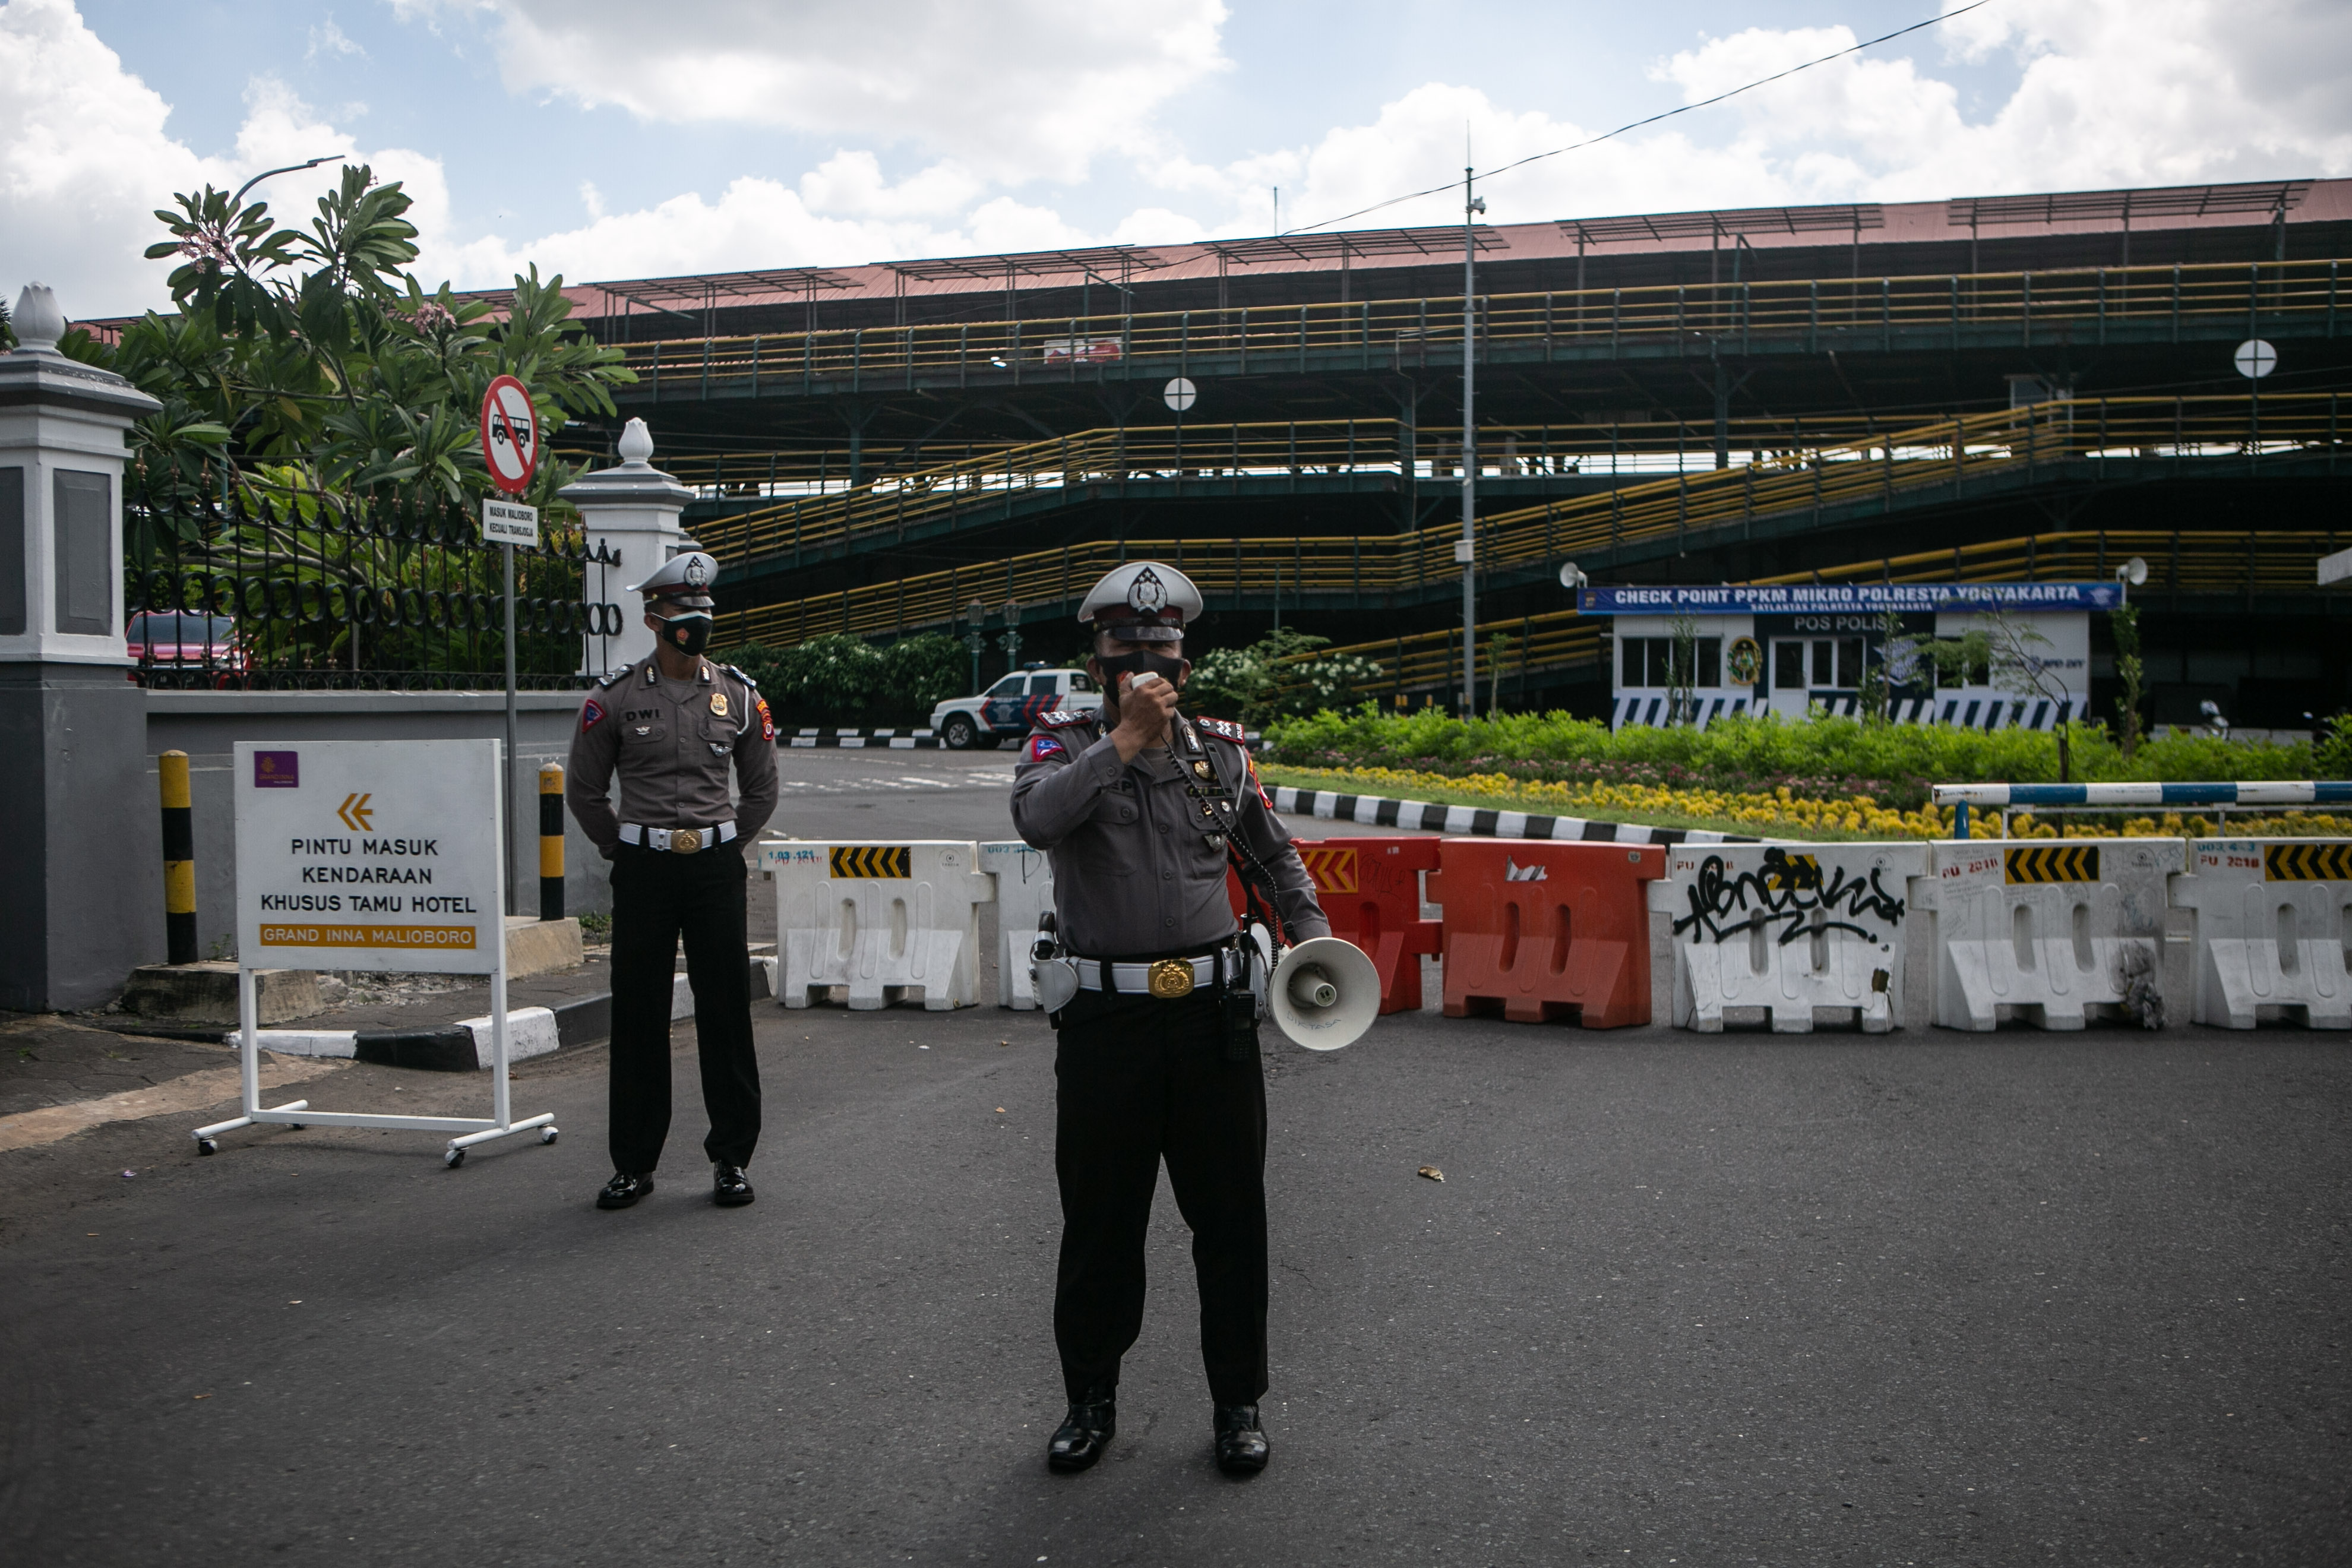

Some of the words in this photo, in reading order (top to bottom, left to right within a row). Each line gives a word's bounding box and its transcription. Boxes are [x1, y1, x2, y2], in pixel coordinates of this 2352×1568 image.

[489, 506, 507, 518] MASUK
[508, 508, 533, 521] MALIOBORO
[489, 523, 507, 533] KECUALI
[508, 524, 533, 537] TRANSJOGJA
[1615, 590, 1672, 604] CHECK
[1677, 589, 1730, 603] POINT
[1734, 589, 1787, 603] PPKM
[1792, 587, 1852, 602] MIKRO
[1858, 586, 1950, 602] POLRESTA
[1956, 585, 2080, 601] YOGYAKARTA
[1751, 602, 1808, 612] SATLANTAS
[1812, 602, 1863, 612] POLRESTA
[1864, 602, 1933, 611] YOGYAKARTA
[1794, 616, 1831, 631] POS
[625, 709, 659, 722] DWI
[292, 839, 351, 855] PINTU
[363, 839, 438, 856] MASUK
[302, 867, 432, 884] KENDARAAN
[261, 894, 342, 911] KHUSUS
[349, 896, 402, 912] TAMU
[412, 896, 477, 913] HOTEL
[263, 928, 320, 942] GRAND
[326, 930, 365, 943] INNA
[372, 930, 472, 944] MALIOBORO
[1286, 1010, 1342, 1030] DIKTASA
